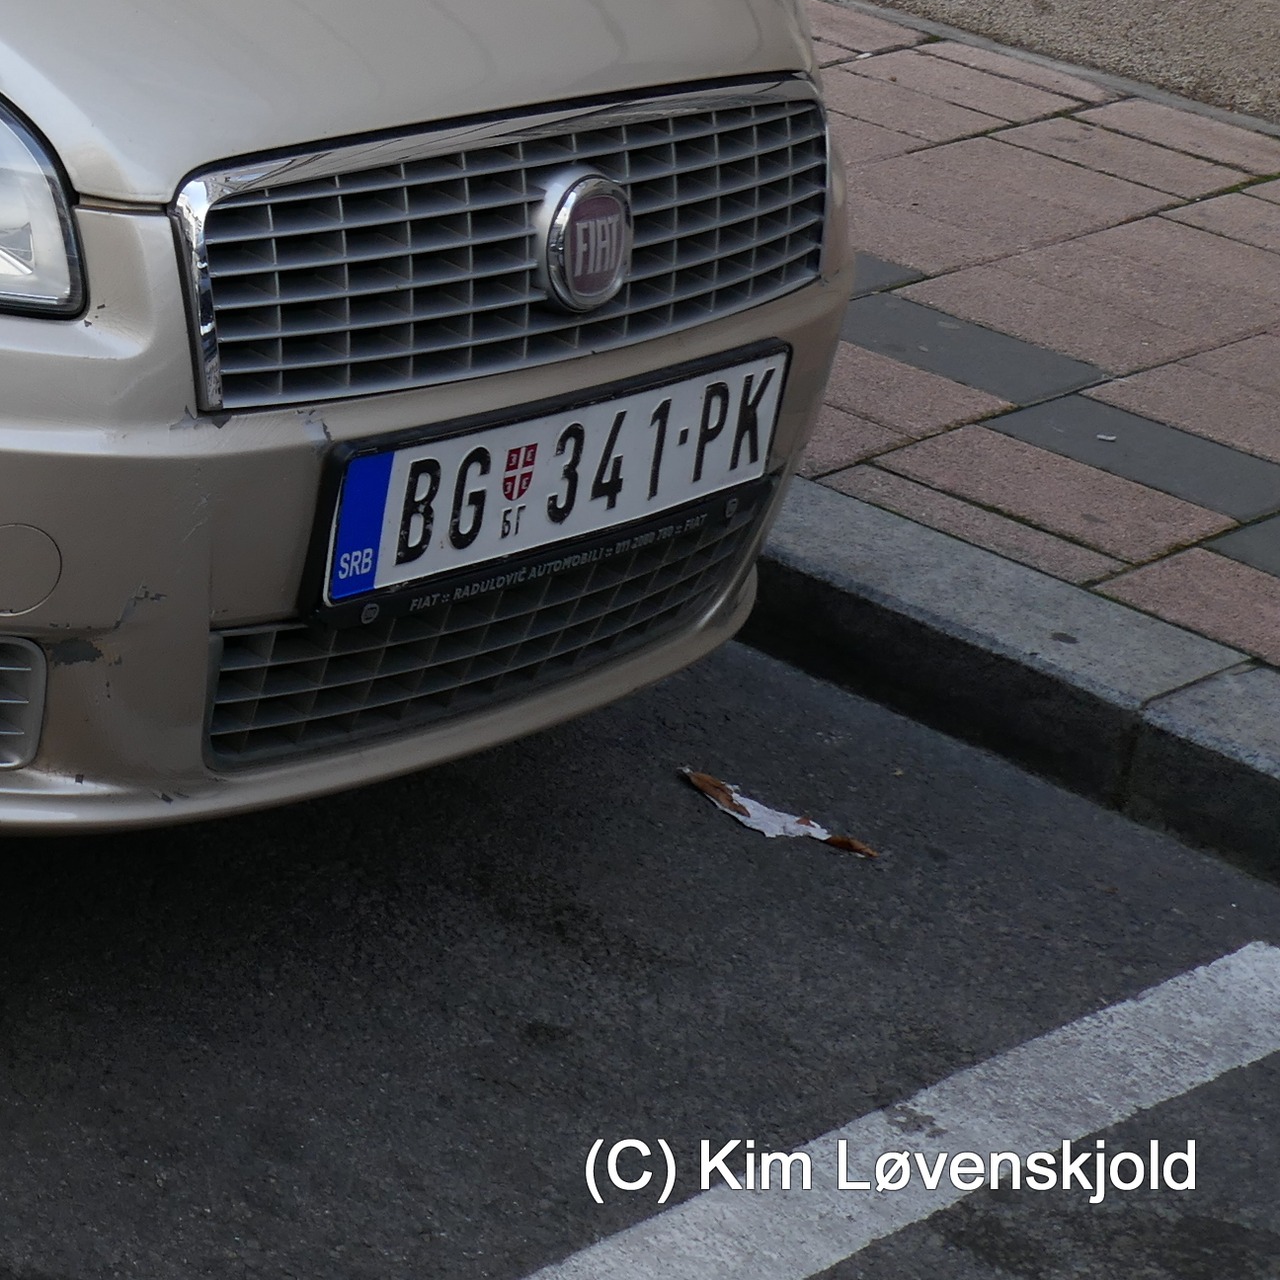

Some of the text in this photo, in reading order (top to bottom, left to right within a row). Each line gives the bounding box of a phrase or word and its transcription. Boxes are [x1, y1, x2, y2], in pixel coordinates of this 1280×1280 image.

[574, 213, 621, 278] FIAT
[394, 446, 492, 567] BG
[338, 548, 374, 580] SRB
[408, 592, 441, 612] FIAT
[527, 547, 605, 581] AUTOMOBILI
